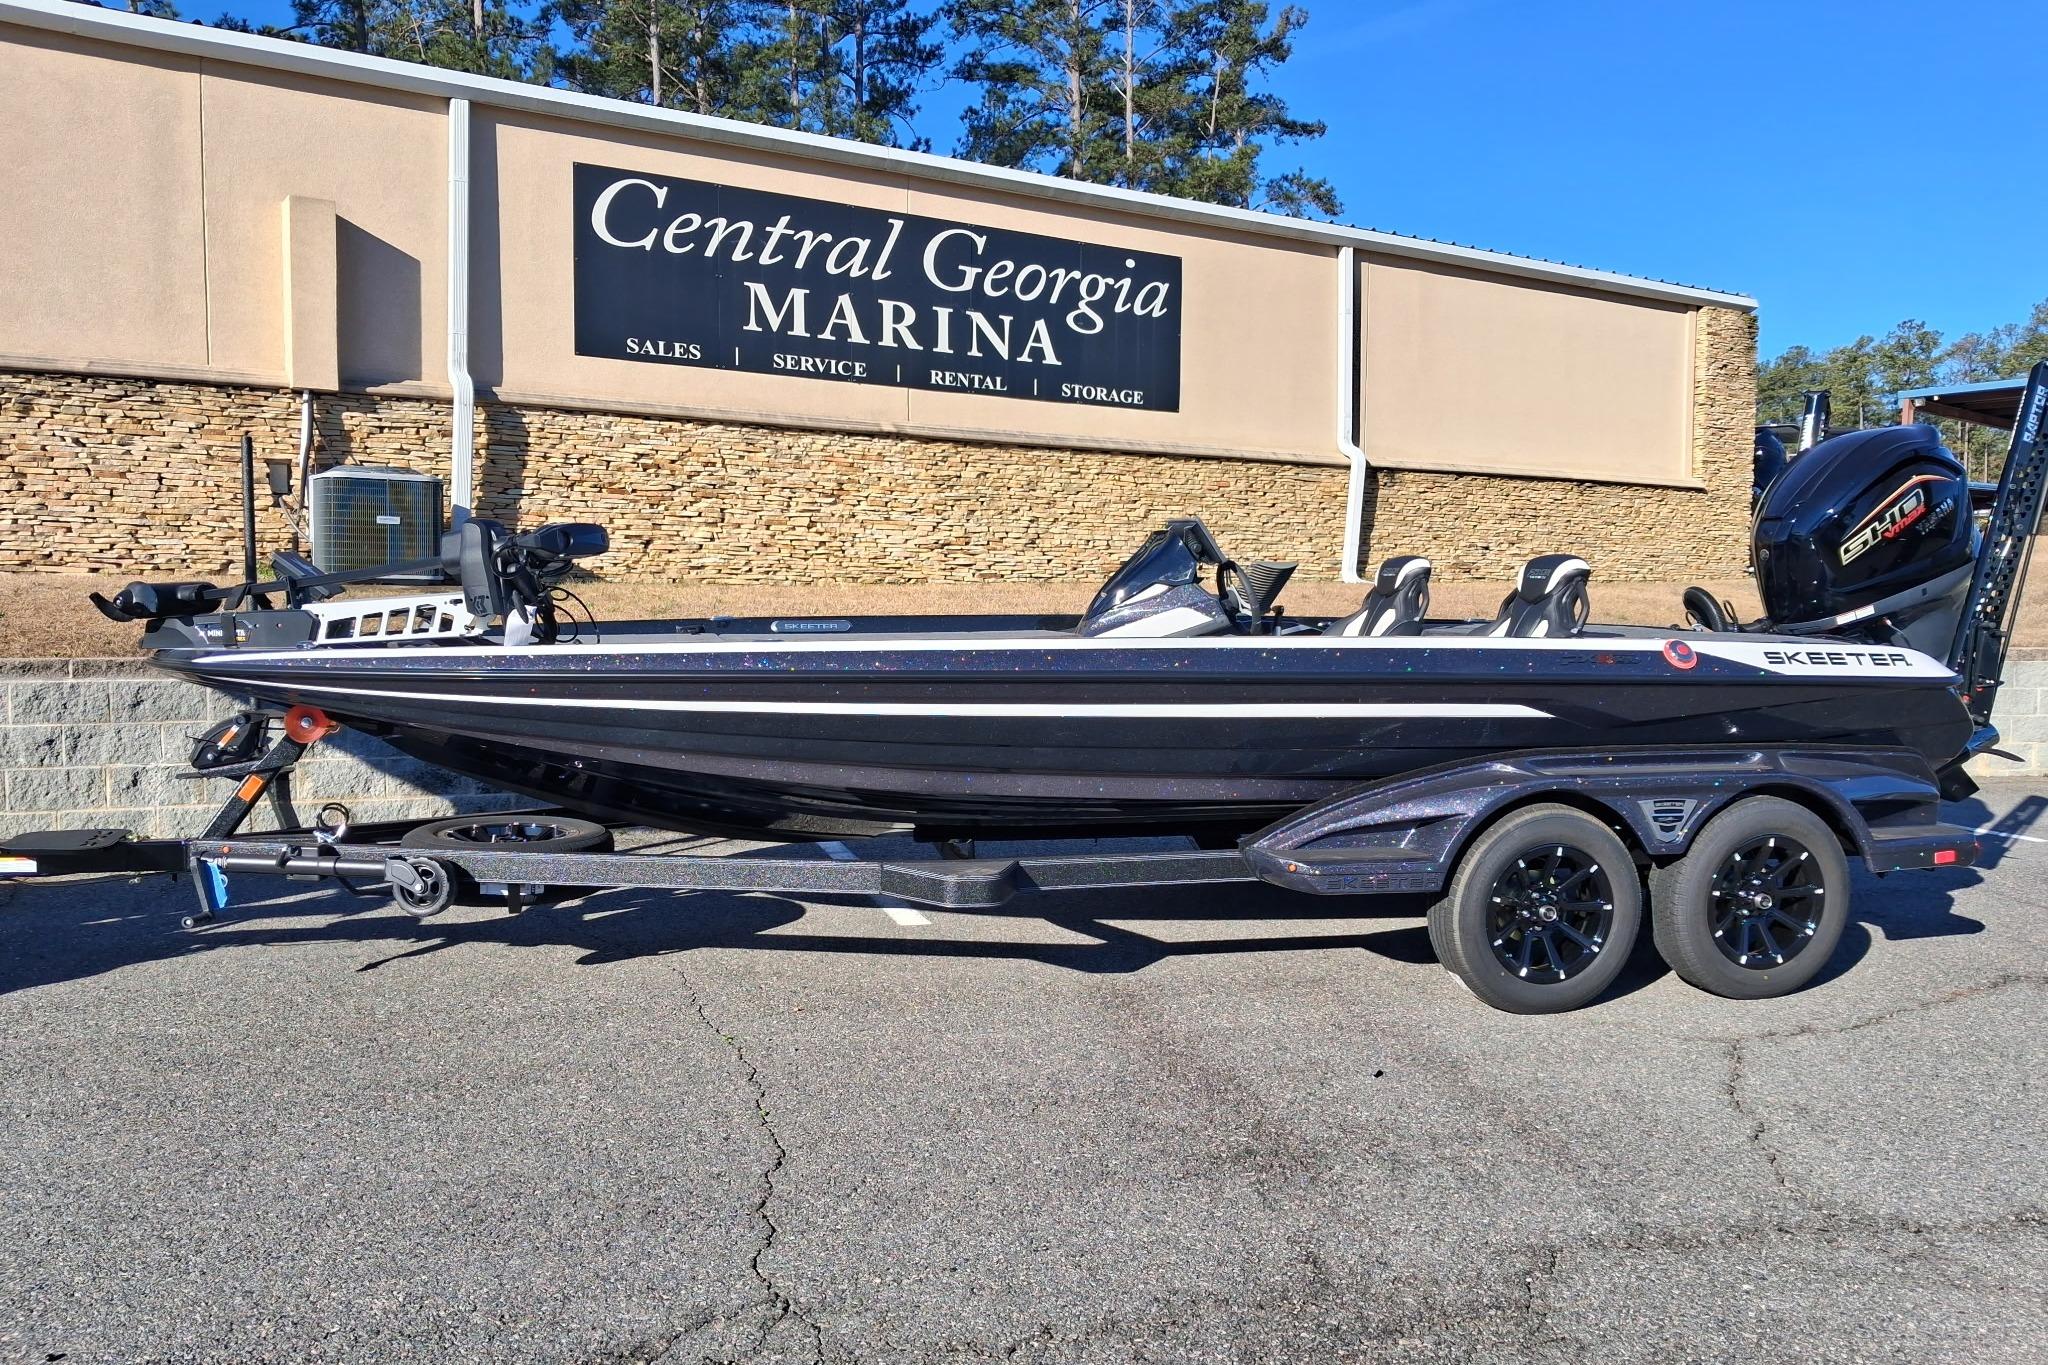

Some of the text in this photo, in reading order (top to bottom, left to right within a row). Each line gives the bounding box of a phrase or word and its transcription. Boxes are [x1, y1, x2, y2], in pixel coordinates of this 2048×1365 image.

[591, 178, 1170, 335] Central Georgia
[742, 281, 1062, 366] MARINA
[626, 337, 1144, 405] SALES SERVICE RENTAL STORAGE
[2023, 385, 2048, 443] RAPTOR
[1839, 488, 1925, 566] SHO
[1763, 651, 1913, 667] SKEETER
[1327, 876, 1439, 890] SKEETER
